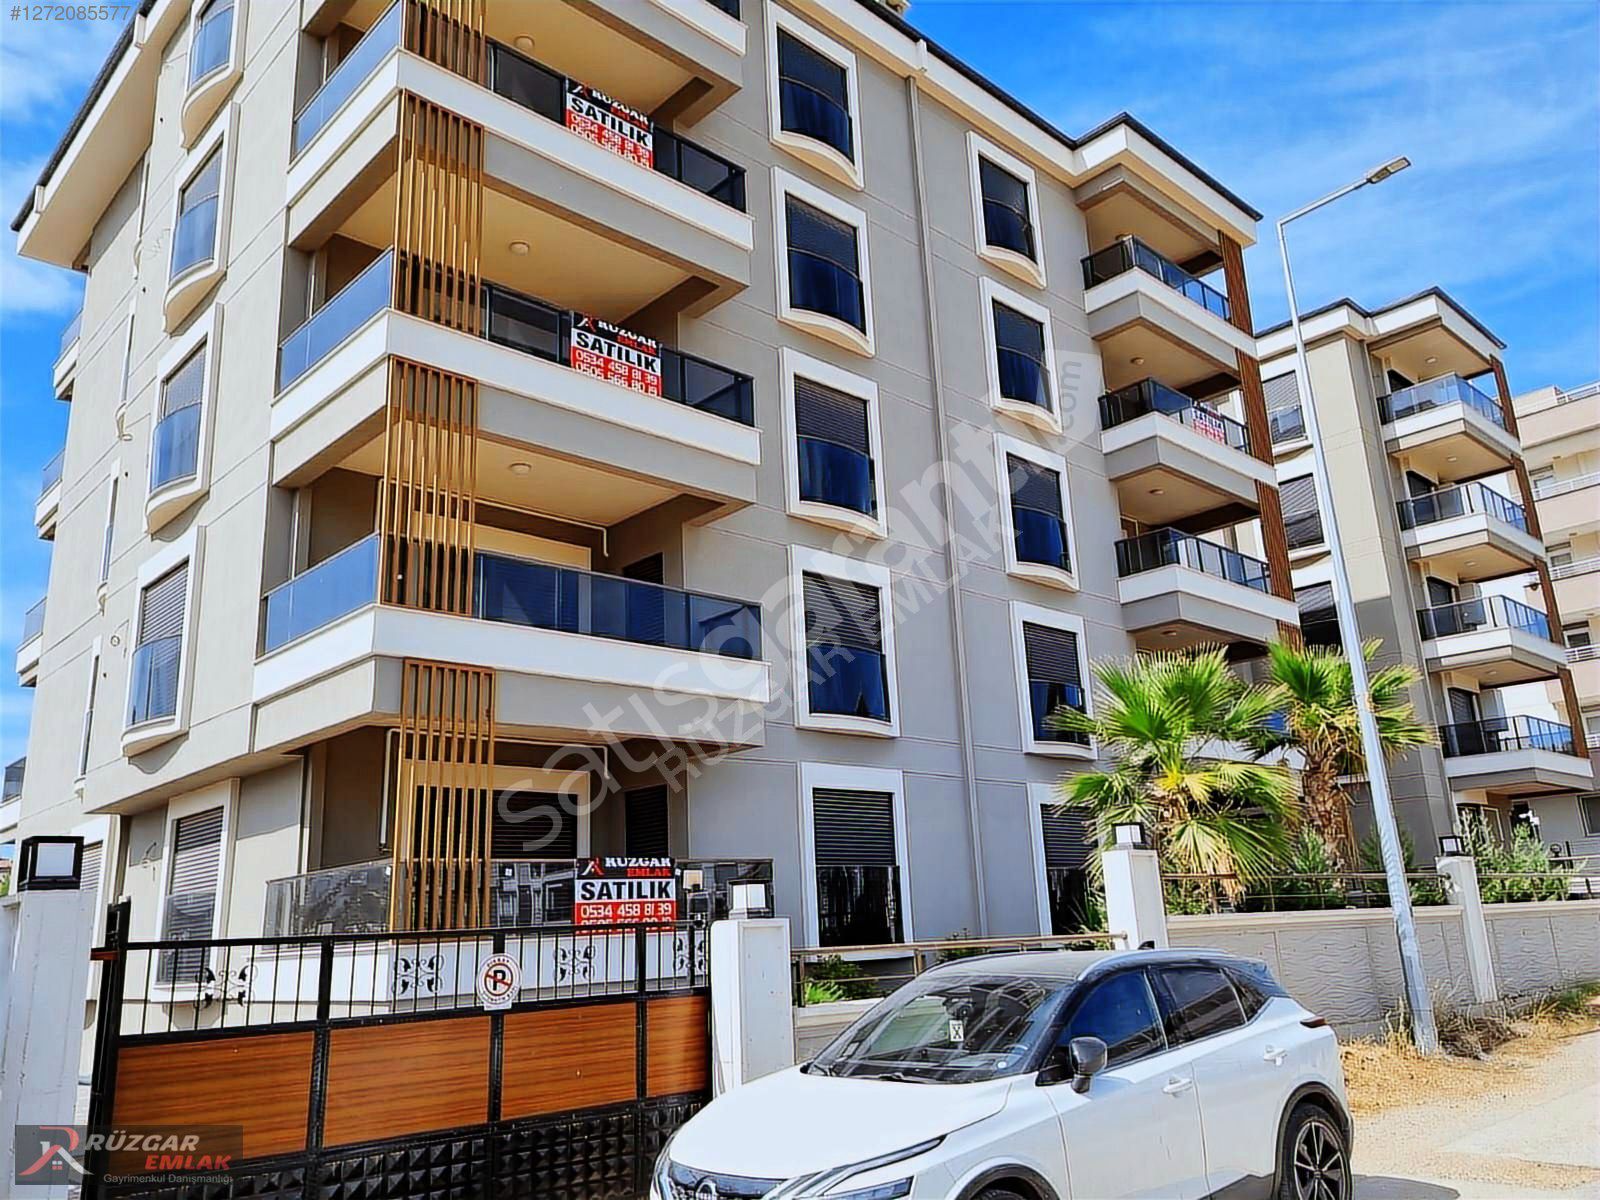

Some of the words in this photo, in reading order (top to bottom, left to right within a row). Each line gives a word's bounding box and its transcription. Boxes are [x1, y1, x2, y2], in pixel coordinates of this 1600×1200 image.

[571, 98, 649, 147] SATILIK
[576, 332, 657, 373] SATILIK
[576, 350, 604, 368] 0534
[580, 880, 671, 901] SATILIK
[580, 904, 613, 918] 0534
[617, 903, 641, 917] 458
[657, 902, 672, 915] 39
